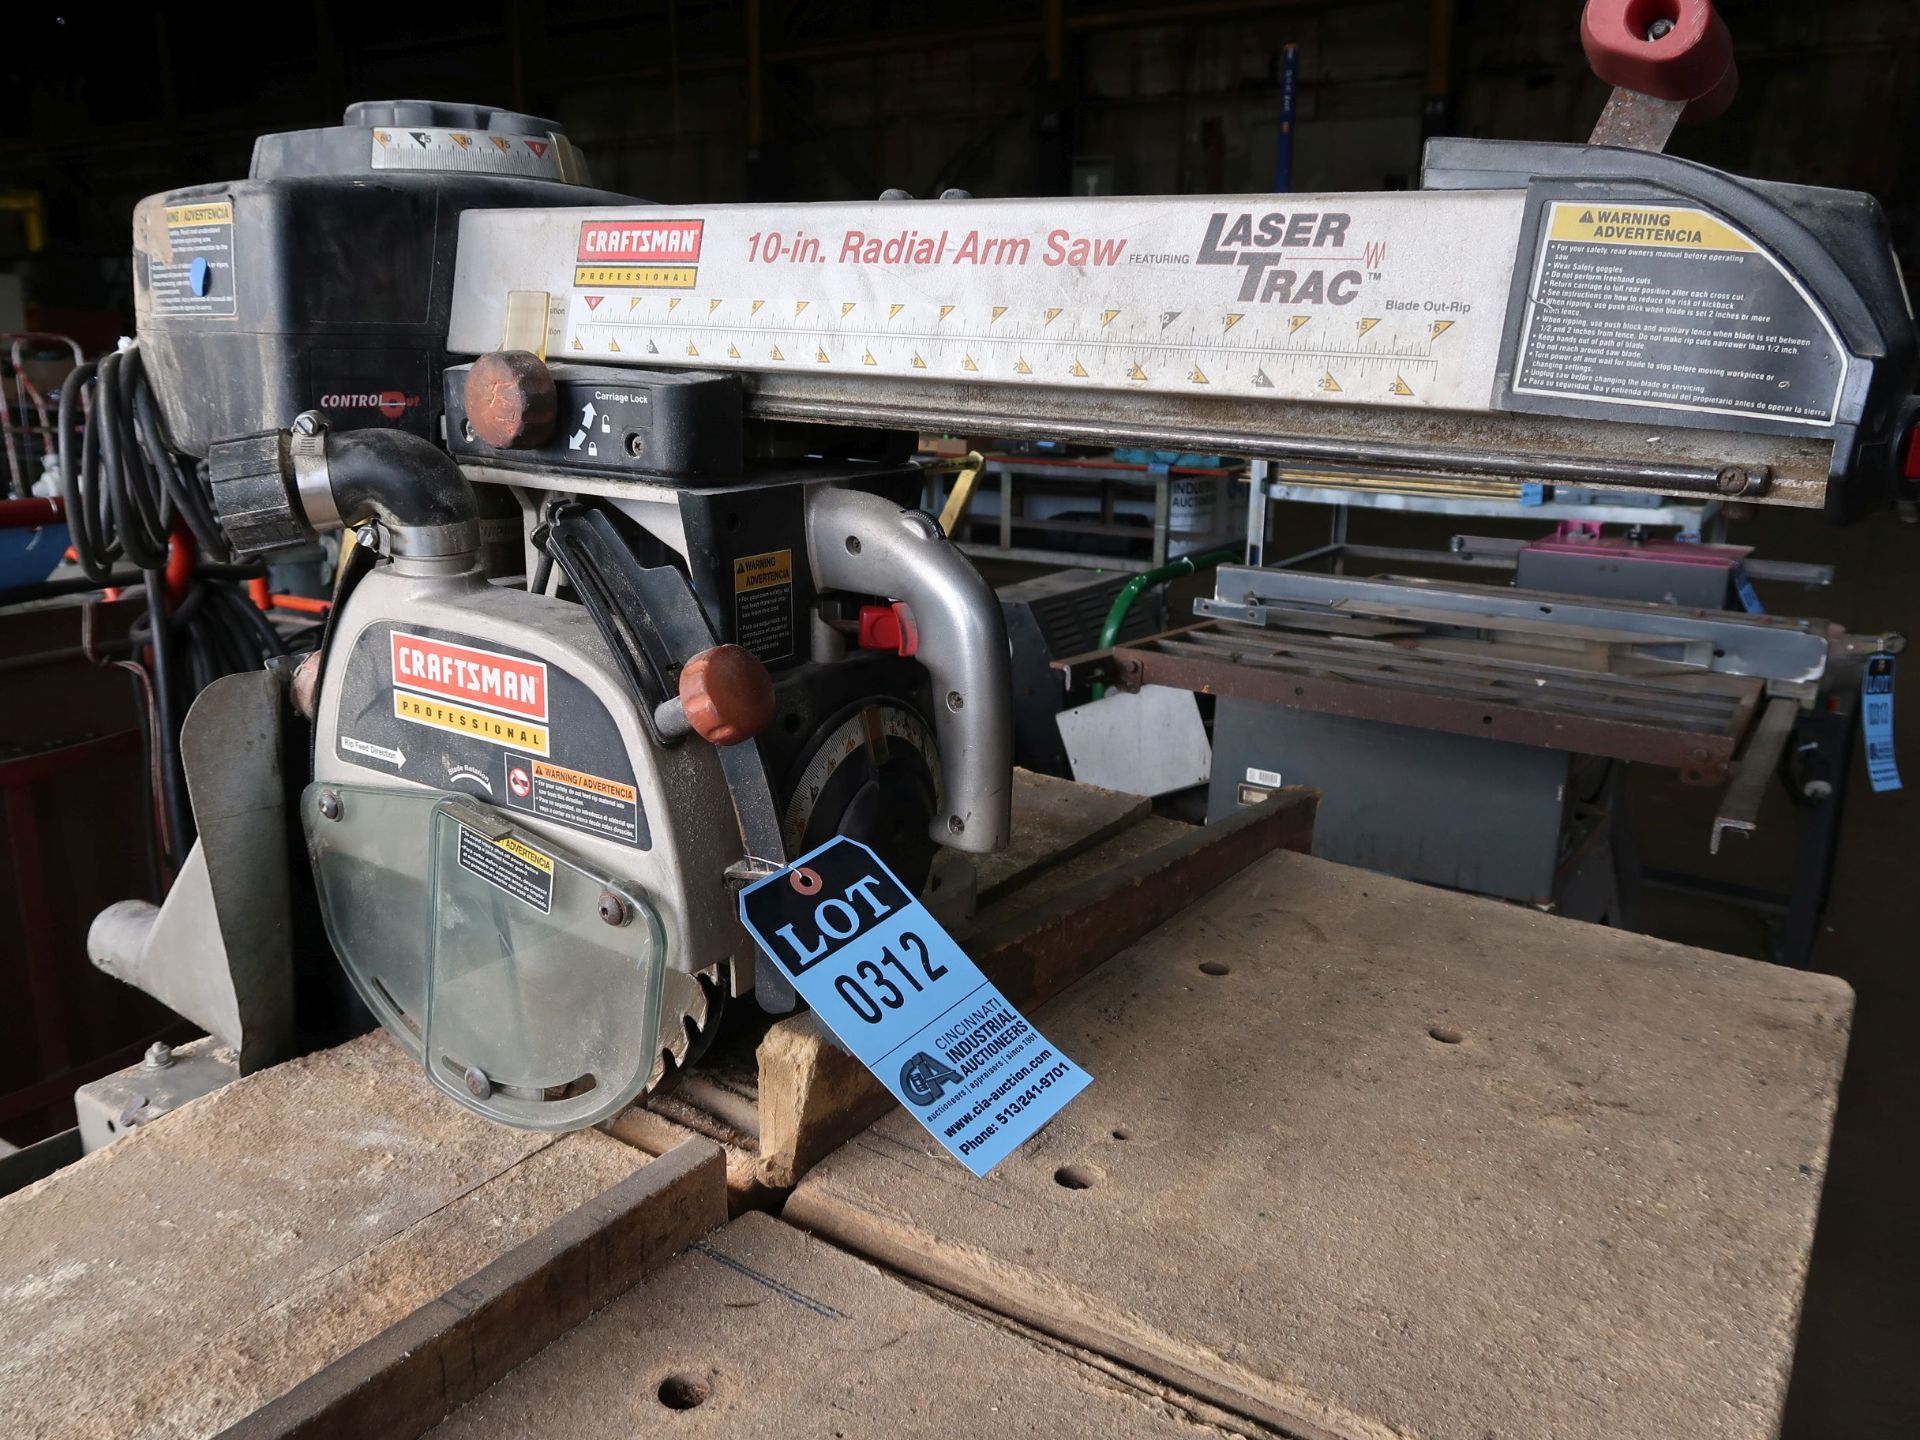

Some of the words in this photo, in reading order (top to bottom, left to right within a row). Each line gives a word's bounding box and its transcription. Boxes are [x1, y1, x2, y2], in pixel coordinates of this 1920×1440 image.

[420, 134, 432, 143] 45
[461, 136, 472, 145] 30
[500, 140, 510, 148] 15
[1597, 211, 1670, 226] WARNING
[1196, 212, 1352, 265] LASER
[1594, 226, 1703, 243] ADVERTENCIA
[748, 232, 826, 264] 10-in.
[838, 230, 948, 265] Radial
[953, 230, 1030, 265] Arm
[1042, 229, 1128, 267] Saw
[1128, 254, 1190, 265] FEATURING
[1557, 243, 1568, 251] For
[1570, 245, 1585, 254] your
[1610, 246, 1627, 255] read
[1655, 249, 1682, 258] manual
[1684, 250, 1707, 259] before
[1708, 252, 1744, 263] operating
[580, 272, 689, 282] PROFESSIONAL
[1551, 269, 1560, 278] Do
[1562, 271, 1573, 279] not
[1574, 272, 1602, 282] perform
[1603, 273, 1634, 283] freehand
[1553, 260, 1571, 270] Wear
[1572, 262, 1594, 273] Safety
[1547, 287, 1560, 296] See
[1562, 288, 1602, 299] instructions
[1614, 292, 1628, 301] how
[1630, 293, 1638, 302] to
[1638, 295, 1662, 304] reduce
[1664, 296, 1676, 305] the
[1678, 297, 1691, 306] risk
[1693, 298, 1701, 307] of
[1549, 278, 1572, 288] Return
[1573, 281, 1602, 292] carriage
[1604, 282, 1611, 291] to
[1612, 283, 1624, 292] full
[1641, 286, 1670, 296] position
[1671, 288, 1689, 297] after
[1690, 290, 1708, 298] each
[1709, 292, 1730, 300] cross
[1385, 299, 1420, 311] Blade
[1423, 300, 1471, 314] Out-Rip
[1158, 313, 1170, 325] 12
[1221, 315, 1233, 326] 13
[1286, 317, 1299, 328] 14
[1355, 320, 1368, 331] 15
[1427, 322, 1441, 333] 16
[1542, 313, 1561, 323] When
[1604, 320, 1621, 330] push
[1622, 321, 1641, 330] block
[1643, 323, 1657, 332] and
[1658, 325, 1689, 337] auxiliary
[1691, 327, 1711, 337] fence
[1713, 329, 1733, 339] when
[1734, 331, 1755, 341] blade
[1756, 333, 1763, 341] is
[1765, 334, 1777, 343] set
[1779, 335, 1811, 346] between
[1536, 341, 1545, 349] Do
[1547, 342, 1558, 351] not
[1560, 344, 1578, 353] reach
[1580, 347, 1604, 355] around
[1538, 331, 1555, 343] Keep
[1556, 333, 1577, 343] hands
[1578, 336, 1589, 344] out
[1591, 336, 1598, 345] of
[1599, 338, 1615, 347] path
[1616, 339, 1623, 347] of
[1013, 363, 1023, 371] 20
[1126, 368, 1139, 378] 22
[1187, 372, 1200, 382] 23
[1318, 378, 1332, 389] 25
[1388, 381, 1403, 393] 26
[320, 394, 405, 407] CONTROL
[595, 391, 629, 403] Carriage
[630, 394, 648, 404] Lock
[1529, 376, 1544, 386] Para
[1593, 383, 1603, 392] lea
[1605, 386, 1609, 395] y
[1611, 386, 1641, 396] entienda
[1643, 389, 1650, 397] el
[1651, 391, 1678, 400] manual
[1680, 393, 1691, 402] del
[1692, 395, 1733, 406] propietario
[1734, 399, 1755, 408] antes
[1756, 401, 1766, 410] de
[1768, 404, 1792, 413] operar
[1794, 405, 1801, 414] la
[745, 557, 776, 571] WARNING
[746, 569, 790, 586] ADVERTENCIA
[402, 701, 539, 745] PROFESSIONAL
[344, 738, 354, 748] Rip
[355, 741, 370, 752] Feed
[370, 745, 397, 759] Direction
[448, 765, 464, 775] Blade
[464, 764, 490, 782] Rotation
[545, 768, 577, 785] WARNING
[583, 778, 633, 799] ADVERTENCIA
[505, 840, 551, 871] ADVERTENCIA
[775, 874, 892, 967] LOT
[834, 931, 949, 1025] 0312
[935, 997, 1002, 1050] CINCINNATI
[945, 1008, 1018, 1065] INDUSTRIAL
[959, 1020, 1029, 1078] AUCTIONEERS
[926, 1088, 967, 1123] auctioneers
[969, 1060, 1004, 1090] appraisers
[1006, 1044, 1025, 1061] since
[1022, 1032, 1039, 1046] 1961
[944, 1049, 1053, 1138] www.cia-auction.com
[958, 1123, 1000, 1156] Phone:
[995, 1061, 1071, 1125] 513/241-9701
